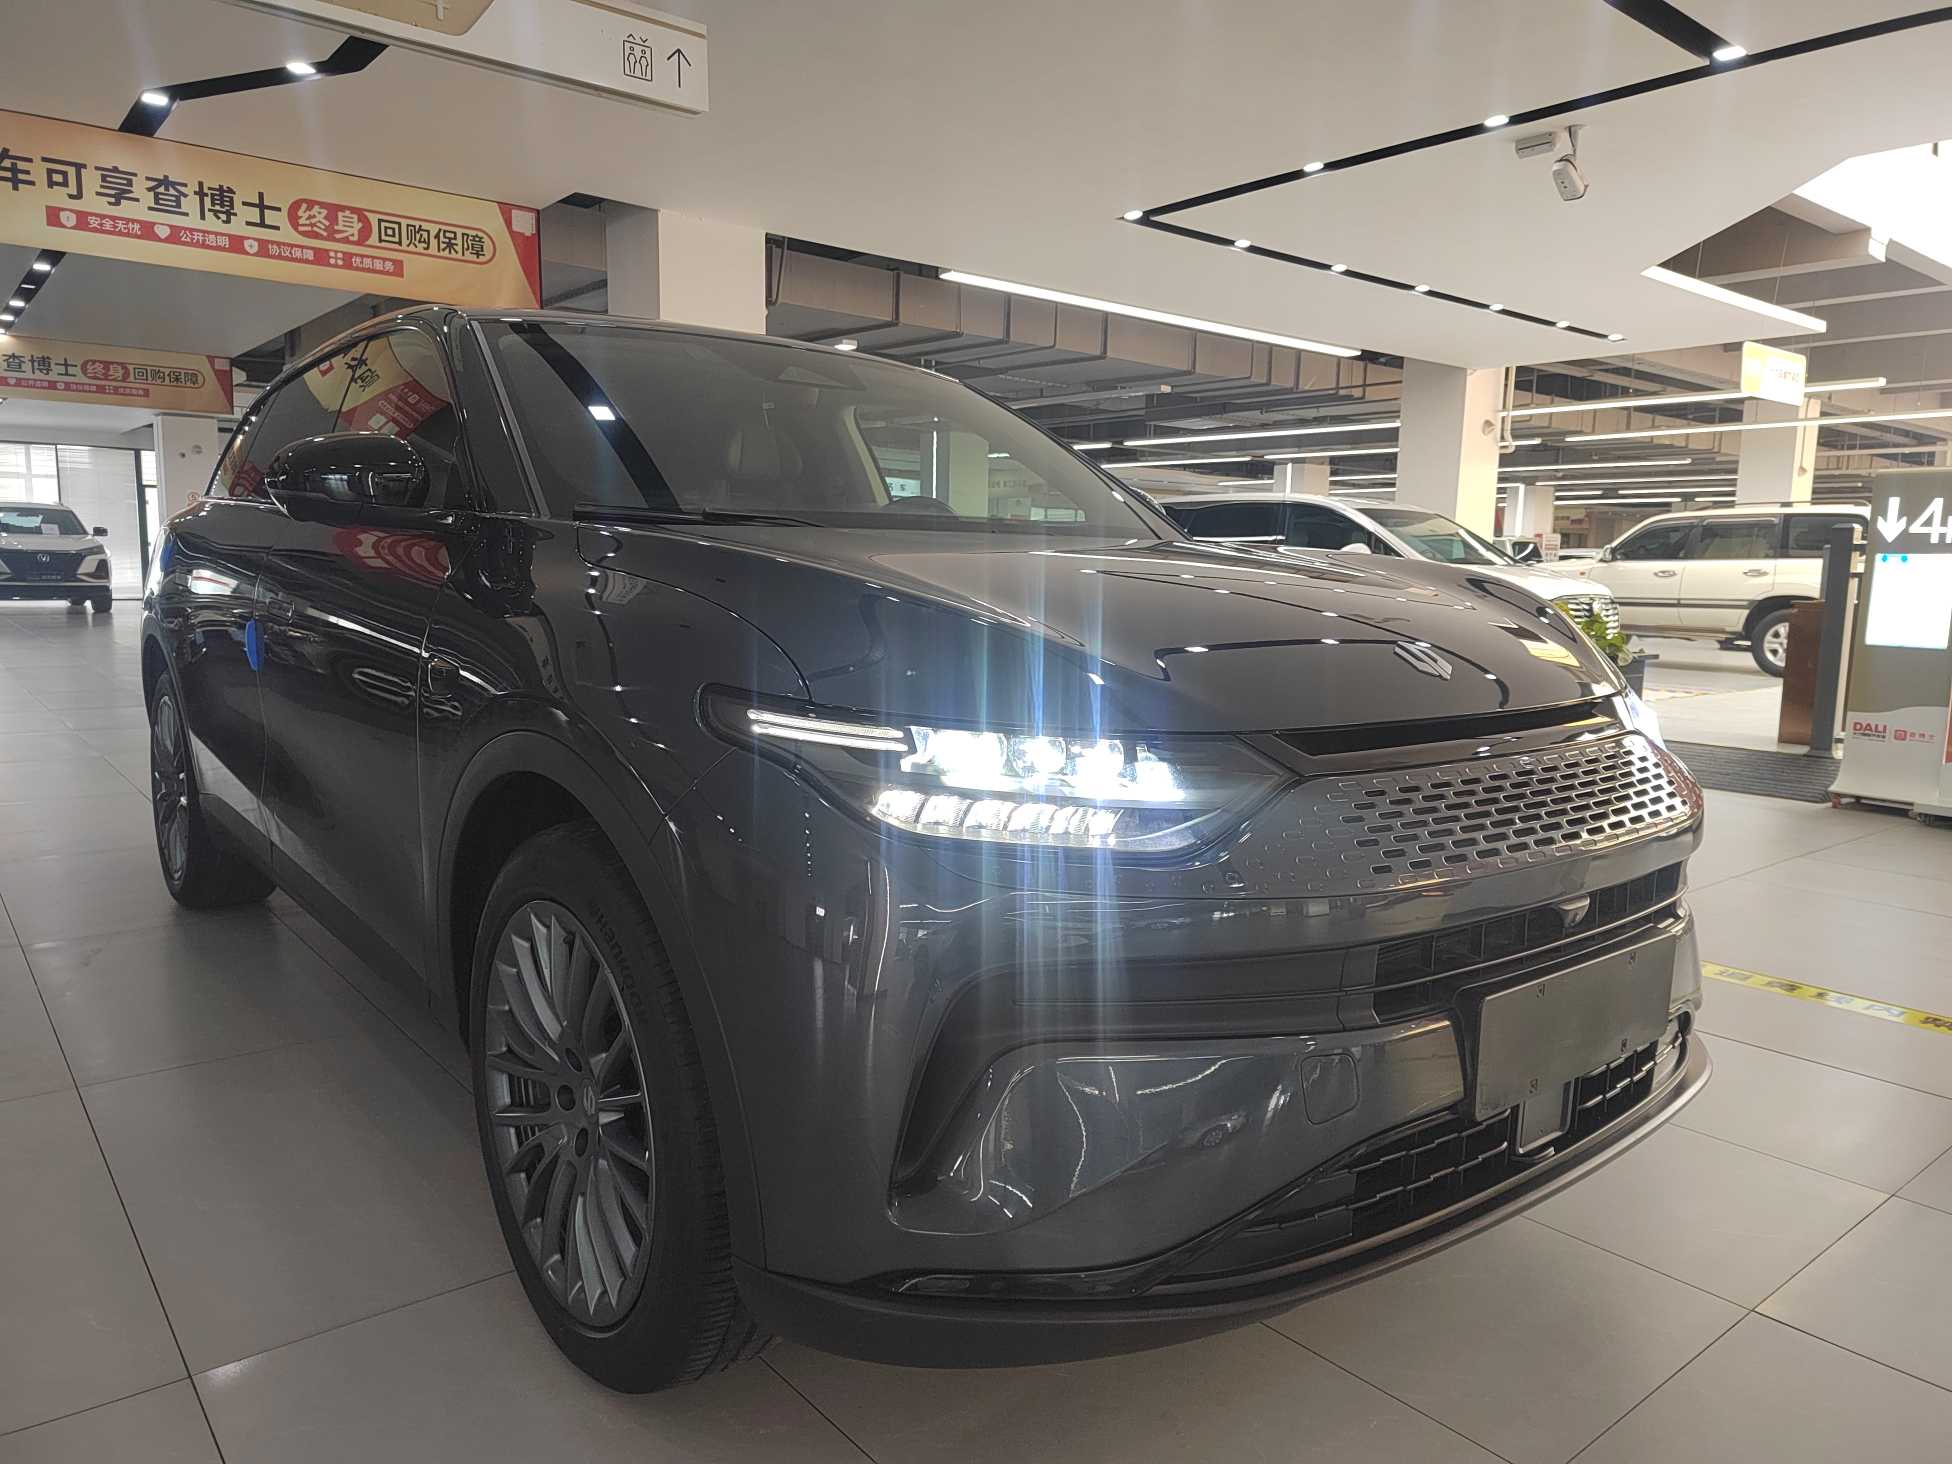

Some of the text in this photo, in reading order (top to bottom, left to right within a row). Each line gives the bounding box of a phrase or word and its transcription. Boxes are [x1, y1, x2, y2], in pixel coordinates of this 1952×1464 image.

[0, 147, 486, 260] 车可享查博士 终身 回购保障
[87, 215, 142, 235] 安全无忧
[179, 230, 230, 248] 公开透明
[268, 243, 314, 261] 协议保障
[352, 256, 395, 273] 优质服务
[2, 353, 199, 386] 查博士 终身 回购保障
[1852, 721, 1888, 734] DALI
